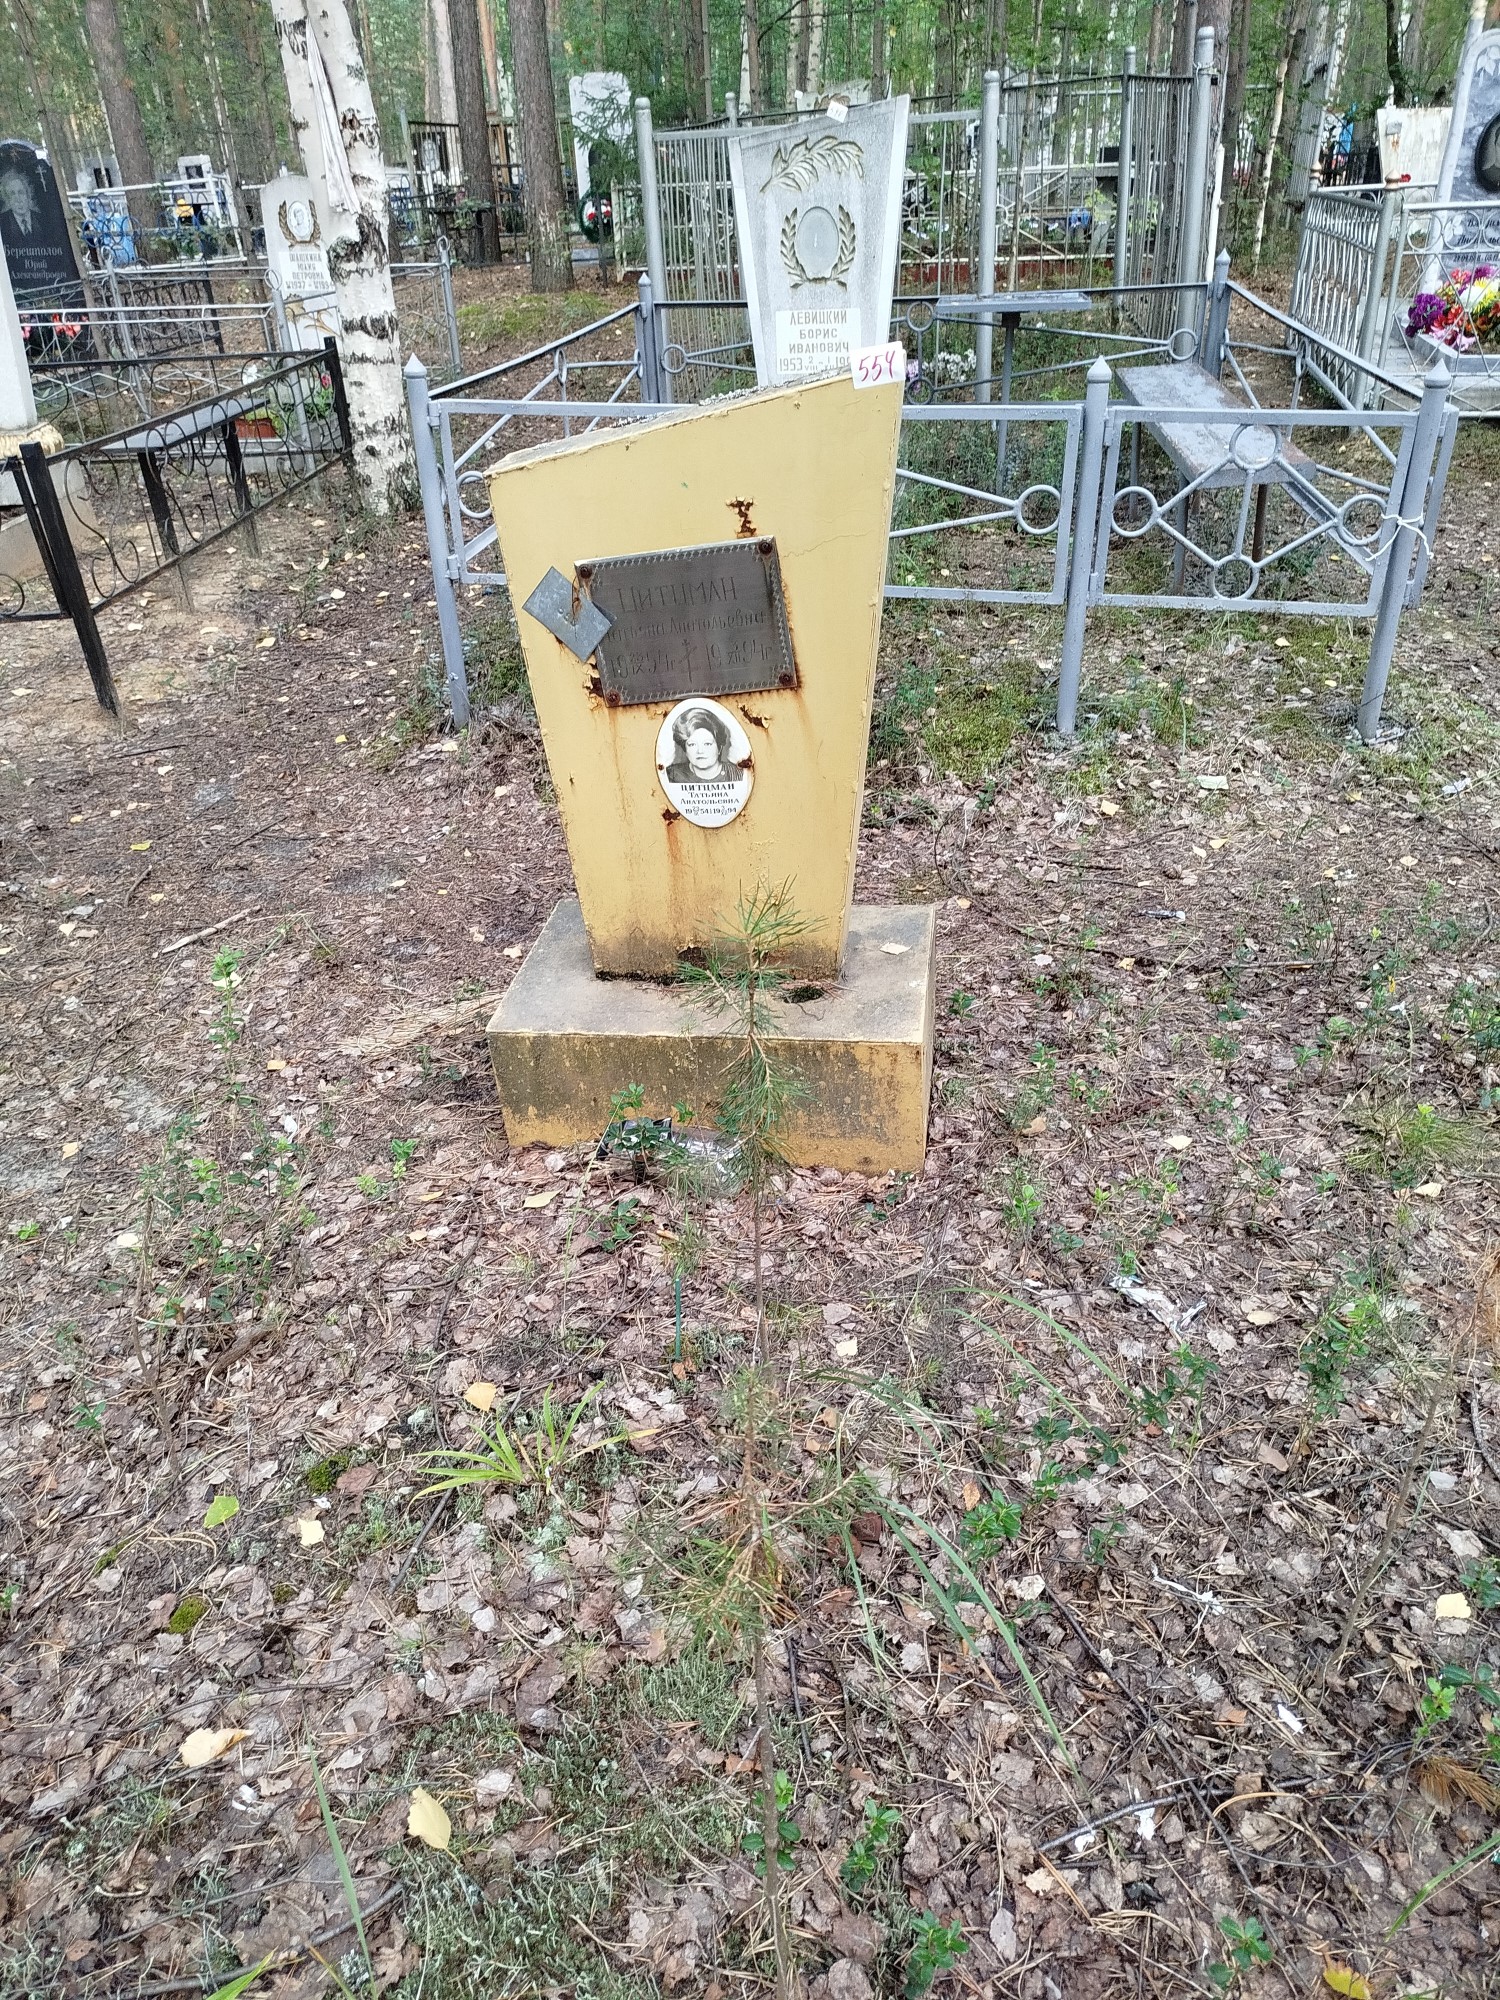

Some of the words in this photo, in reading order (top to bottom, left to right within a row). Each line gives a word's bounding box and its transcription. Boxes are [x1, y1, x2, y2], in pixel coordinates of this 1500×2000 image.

[799, 328, 838, 340] БОРИС
[789, 342, 849, 354] ИВАНОВИЧ
[779, 358, 803, 372] 1953
[859, 350, 896, 382] 554
[681, 783, 735, 793] ЦИТЦМАН
